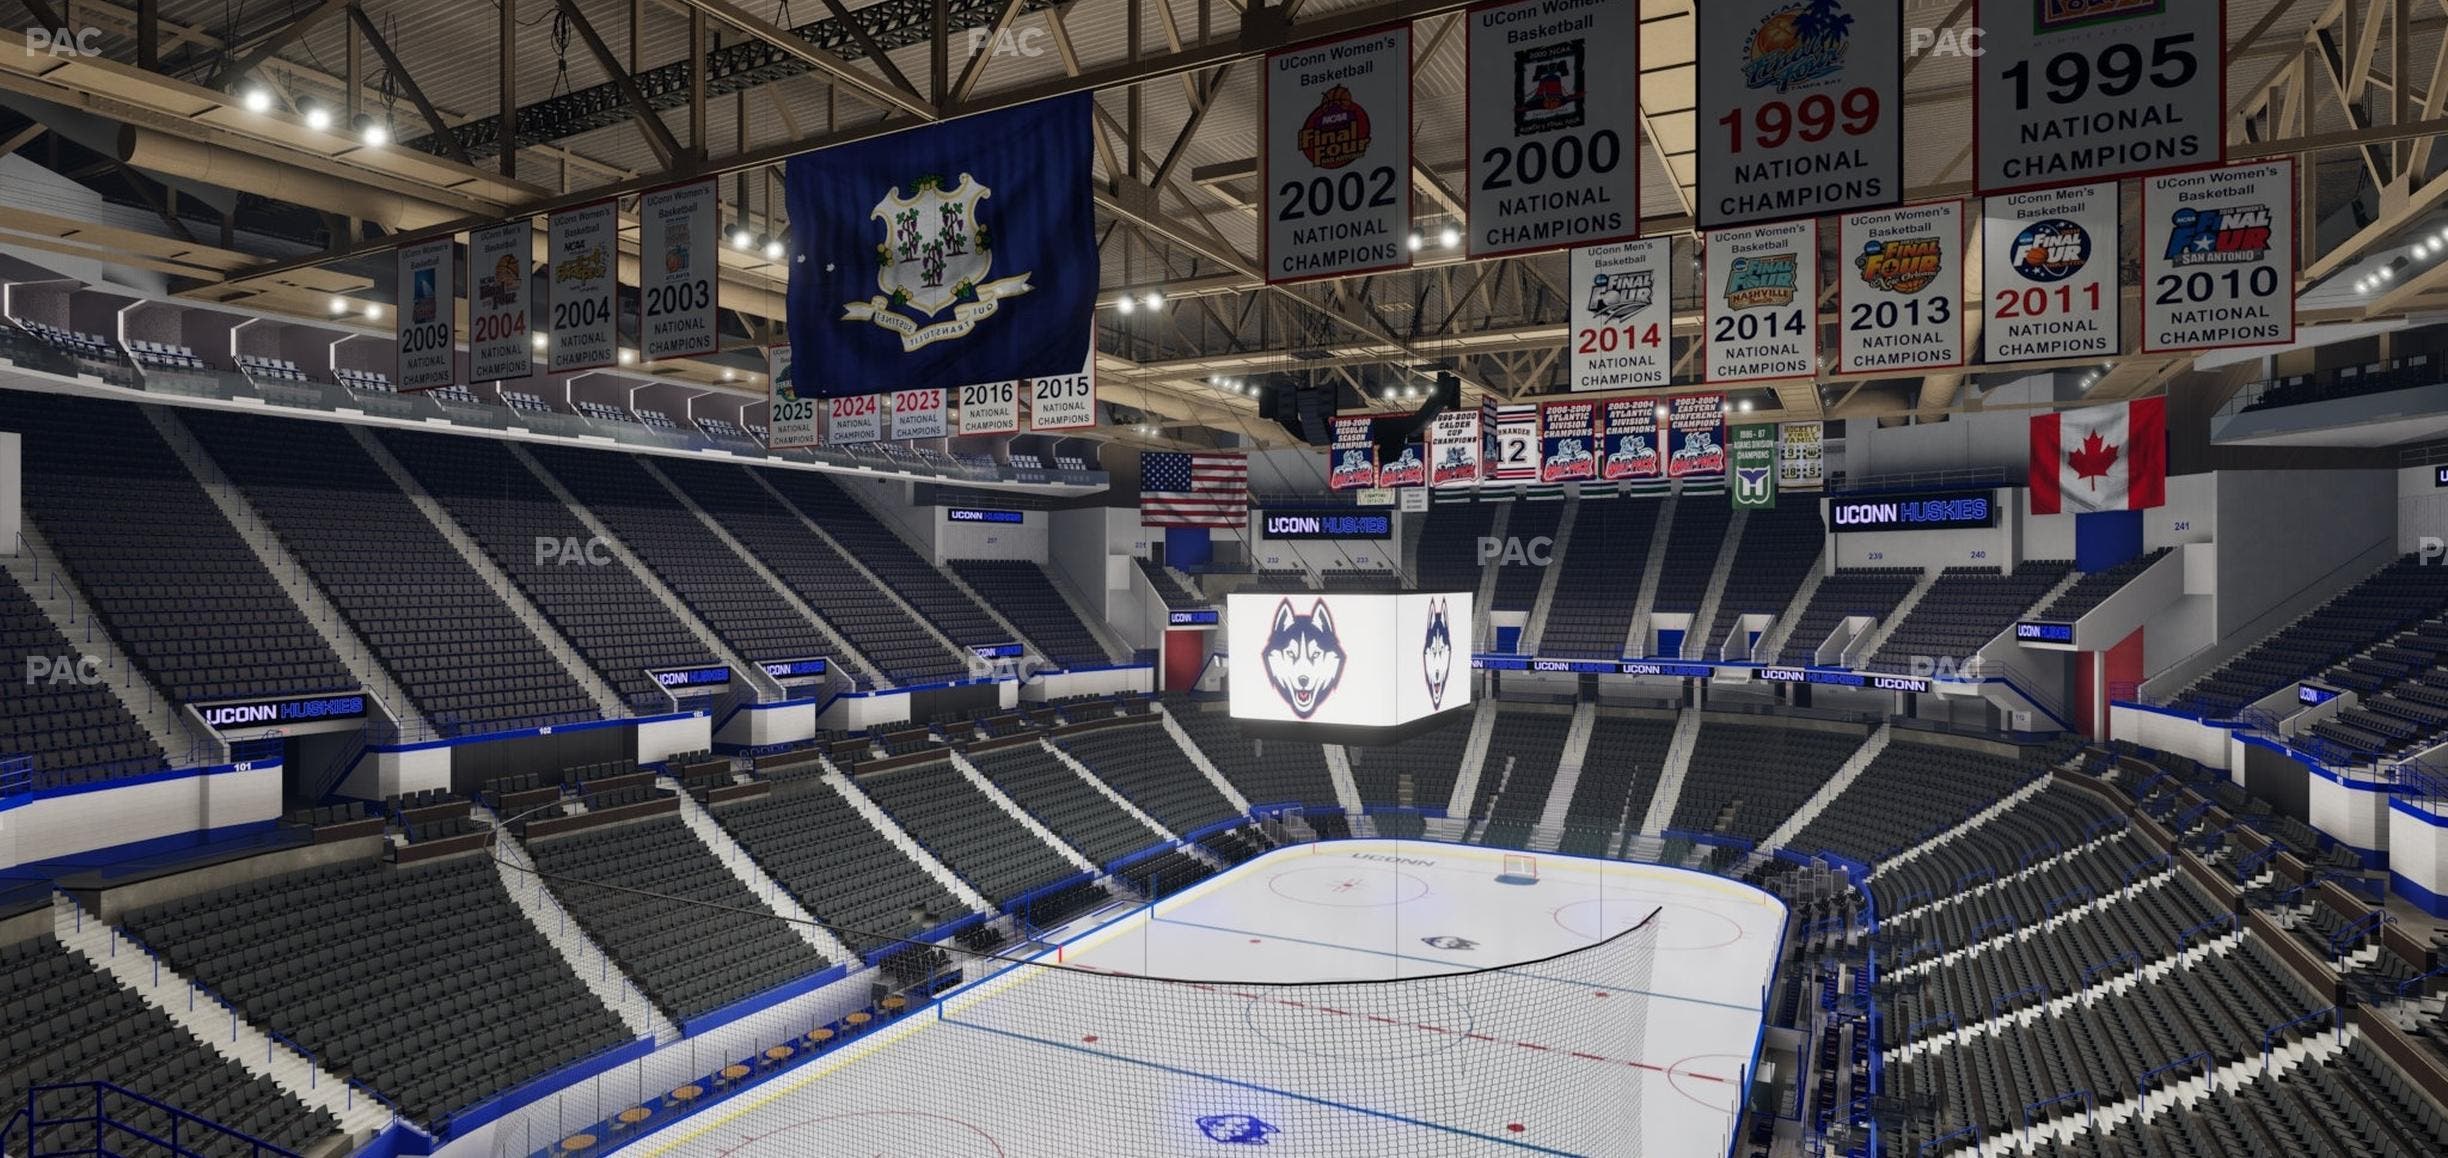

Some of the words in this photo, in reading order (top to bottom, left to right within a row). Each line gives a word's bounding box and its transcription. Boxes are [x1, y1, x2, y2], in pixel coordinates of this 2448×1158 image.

[1483, 8, 1537, 28] UConn
[1507, 14, 1594, 44] Basketball
[1279, 53, 1326, 71] UConn
[1330, 37, 1396, 61] Women's
[1300, 60, 1374, 87] Basketball
[2002, 32, 2197, 111] 1995
[1719, 87, 1880, 154] 1999
[2021, 103, 2183, 144] NATIONAL
[1300, 121, 1358, 148] Final
[1313, 138, 1371, 167] Four
[1482, 129, 1620, 191] 2000
[2003, 134, 2199, 179] CHAMPIONS
[1735, 149, 1868, 184] NATIONAL
[2157, 176, 2205, 189] UConn
[2210, 166, 2277, 183] Women's
[647, 194, 672, 206] UConn
[674, 185, 710, 199] Women's
[1279, 165, 1396, 221] 2002
[1720, 178, 1881, 216] CHAMPIONS
[2008, 194, 2052, 206] UConn
[2056, 187, 2095, 200] Men's
[2179, 184, 2255, 202] Basketball
[1499, 186, 1611, 217] NATIONAL
[658, 203, 698, 219] Basketball
[1851, 214, 1891, 226] UConn
[1895, 206, 1950, 221] Women's
[2017, 203, 2085, 219] Basketball
[564, 224, 600, 239] Basketball
[1293, 218, 1388, 246] NATIONAL
[1487, 212, 1622, 246] CHAMPIONS
[1715, 232, 1751, 243] UConn
[1755, 224, 1805, 238] Women's
[1869, 223, 1932, 238] Basketball
[1588, 247, 1620, 256] UConn
[1624, 241, 1653, 252] Men's
[1732, 239, 1788, 253] Basketball
[2033, 233, 2081, 248] FINAL
[1283, 243, 1397, 273] CHAMPIONS
[1885, 242, 1938, 258] FINAL
[2182, 252, 2205, 265] SAN
[2207, 250, 2254, 263] ANTONIO
[1595, 255, 1646, 268] Basketball
[1750, 261, 1794, 273] FINAL
[1864, 255, 1939, 280] FOUR
[1607, 275, 1653, 290] FINAL
[1728, 272, 1794, 293] FOUR
[2156, 266, 2278, 305] 2010
[647, 280, 709, 317] 2003
[1733, 290, 1789, 302] NASHVILLE
[1995, 282, 2100, 319] 2011
[554, 296, 610, 330] 2004
[1850, 296, 1950, 331] 2013
[2171, 305, 2269, 324] NATIONAL
[475, 310, 526, 342] 2004
[654, 318, 705, 334] NATIONAL
[1715, 309, 1806, 342] 2014
[2009, 320, 2098, 337] NATIONAL
[402, 323, 448, 353] 2009
[561, 332, 607, 347] NATIONAL
[1579, 323, 1661, 354] 2014
[1863, 332, 1943, 348] NATIONAL
[2160, 324, 2279, 344] CHAMPIONS
[481, 344, 522, 359] NATIONAL
[649, 335, 710, 354] CHAMPIONS
[1726, 344, 1800, 359] NATIONAL
[1999, 337, 2107, 356] CHAMPIONS
[407, 355, 445, 368] NATIONAL
[556, 349, 611, 366] CHAMPIONS
[1589, 355, 1655, 370] NATIONAL
[1854, 349, 1952, 367] CHAMPIONS
[476, 360, 527, 376] CHAMPIONS
[1718, 360, 1807, 376] CHAMPIONS
[403, 370, 449, 386] CHAMPIONS
[1581, 371, 1662, 386] CHAMPIONS
[964, 383, 1013, 406] 2016
[1036, 376, 1089, 400] 2015
[832, 396, 876, 418] 2024
[896, 390, 940, 412] 2023
[1043, 401, 1085, 412] NATIONAL
[1608, 401, 1654, 411] 2003-2004
[1678, 404, 1716, 413] EASTERN
[773, 402, 813, 422] 2025
[900, 413, 937, 424] NATIONAL
[969, 407, 1009, 418] NATIONAL
[1038, 414, 1090, 426] CHAMPIONS
[1548, 413, 1590, 422] ATLANTIC
[1609, 409, 1652, 418] ATLANTIC
[1670, 411, 1723, 421] CONFERENCE
[777, 424, 811, 434] NATIONAL
[837, 418, 872, 429] NATIONAL
[965, 420, 1014, 431] CHAMPIONS
[1439, 421, 1471, 429] CALDER
[1550, 421, 1587, 430] DIVISION
[1611, 417, 1650, 426] DIVISION
[1672, 419, 1721, 428] CHAMPIONS
[833, 430, 875, 441] CHAMPIONS
[896, 426, 941, 437] CHAMPIONS
[1336, 426, 1368, 435] REGULAR
[1338, 434, 1367, 442] SEASON
[1447, 429, 1463, 437] CUP
[1544, 428, 1592, 438] CHAMPIONS
[1606, 425, 1656, 435] CHAMPIONS
[774, 434, 814, 445] CHAMPIONS
[1332, 441, 1373, 450] CHAMPIONS
[1433, 437, 1477, 445] CHAMPIONS
[1497, 440, 1526, 462] 12
[1737, 450, 1770, 460] CHAMPIONS
[1786, 467, 1796, 477] 18
[1809, 467, 1816, 475] 5
[952, 511, 983, 520] UCONN
[1836, 503, 1897, 525] UCONN
[1901, 498, 1988, 523] HUSKIES
[1268, 517, 1320, 533] UCONN
[1322, 516, 1387, 534] HUSKIES
[2174, 522, 2190, 531] 241
[1868, 552, 1883, 561] 239
[1970, 551, 1985, 560] 240
[1171, 613, 1192, 623] UCONN
[2018, 624, 2041, 638] UCONN
[1534, 662, 1569, 671] UCONN
[1623, 665, 1660, 674] UCONN
[1761, 669, 1804, 682] UCONN
[1874, 677, 1926, 692] UCONN
[206, 704, 277, 725] UCONN
[281, 697, 363, 719] HUSKIES
[234, 762, 251, 772] 101
[1352, 852, 1435, 867] UCONN
